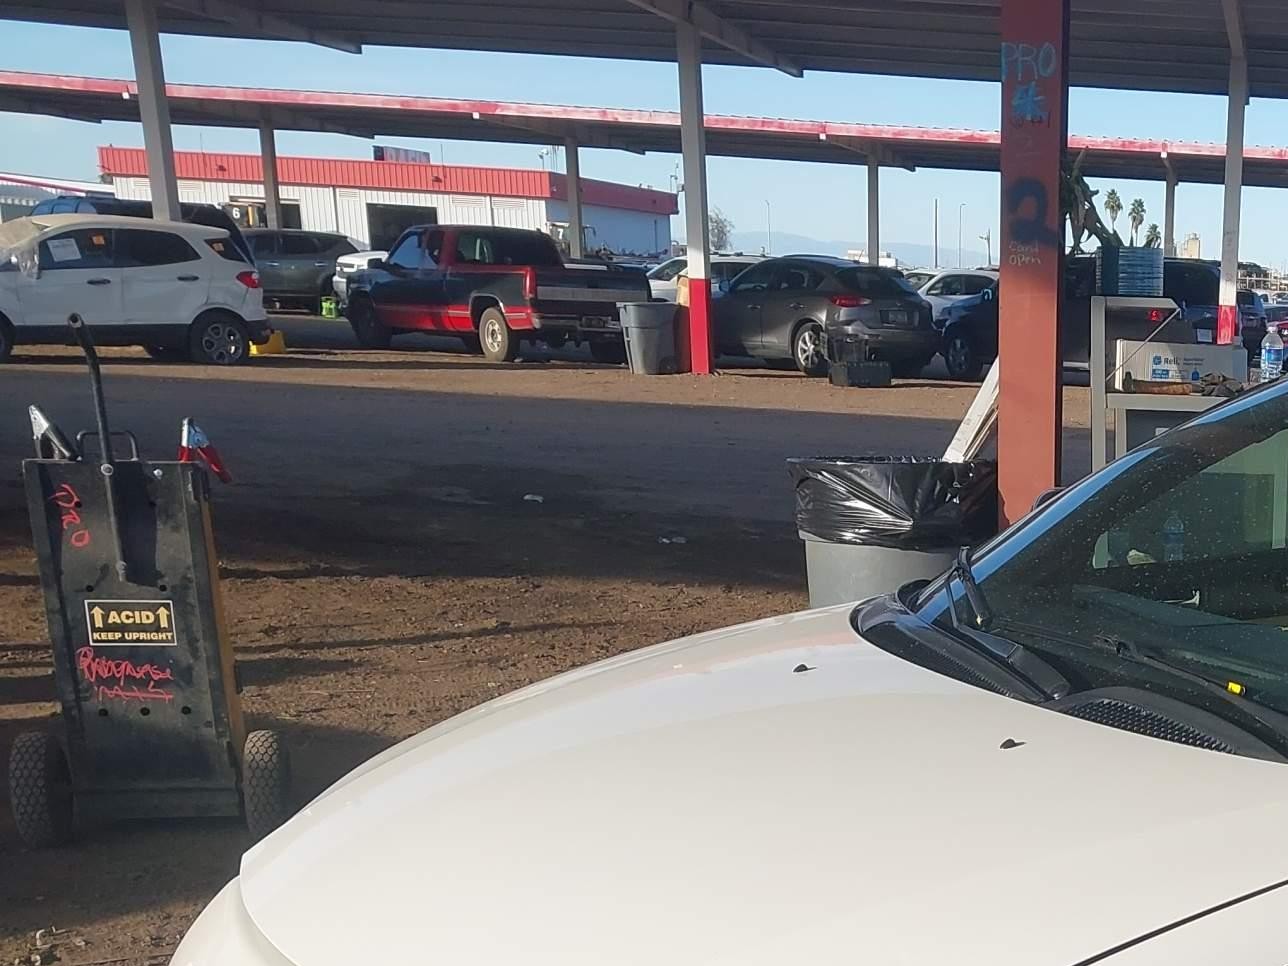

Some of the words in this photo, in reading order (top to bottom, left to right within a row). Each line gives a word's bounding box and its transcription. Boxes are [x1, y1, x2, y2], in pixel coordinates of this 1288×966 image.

[1001, 42, 1056, 81] PRO
[232, 207, 240, 219] 6
[107, 610, 155, 624] ACID
[92, 632, 122, 640] KEEP
[124, 632, 173, 641] UPRIGHT
